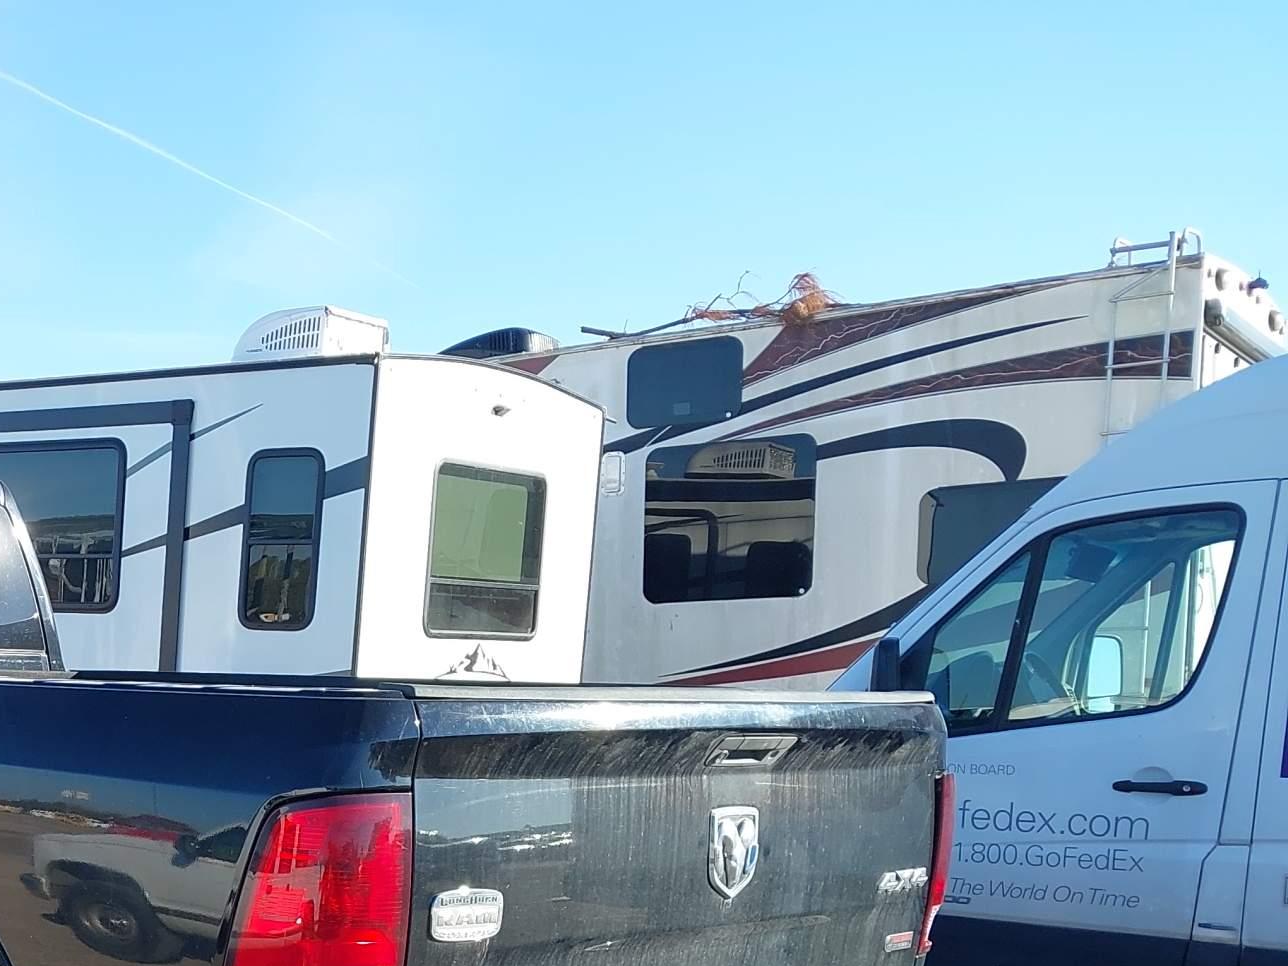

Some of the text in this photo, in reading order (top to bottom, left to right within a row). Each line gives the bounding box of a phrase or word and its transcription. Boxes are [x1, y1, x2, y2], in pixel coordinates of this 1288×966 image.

[947, 763, 1016, 776] ON BOARD
[958, 799, 1150, 840] fedex.com
[954, 841, 1145, 873] 1.800.GoFedEx
[951, 877, 1141, 909] The World On Time
